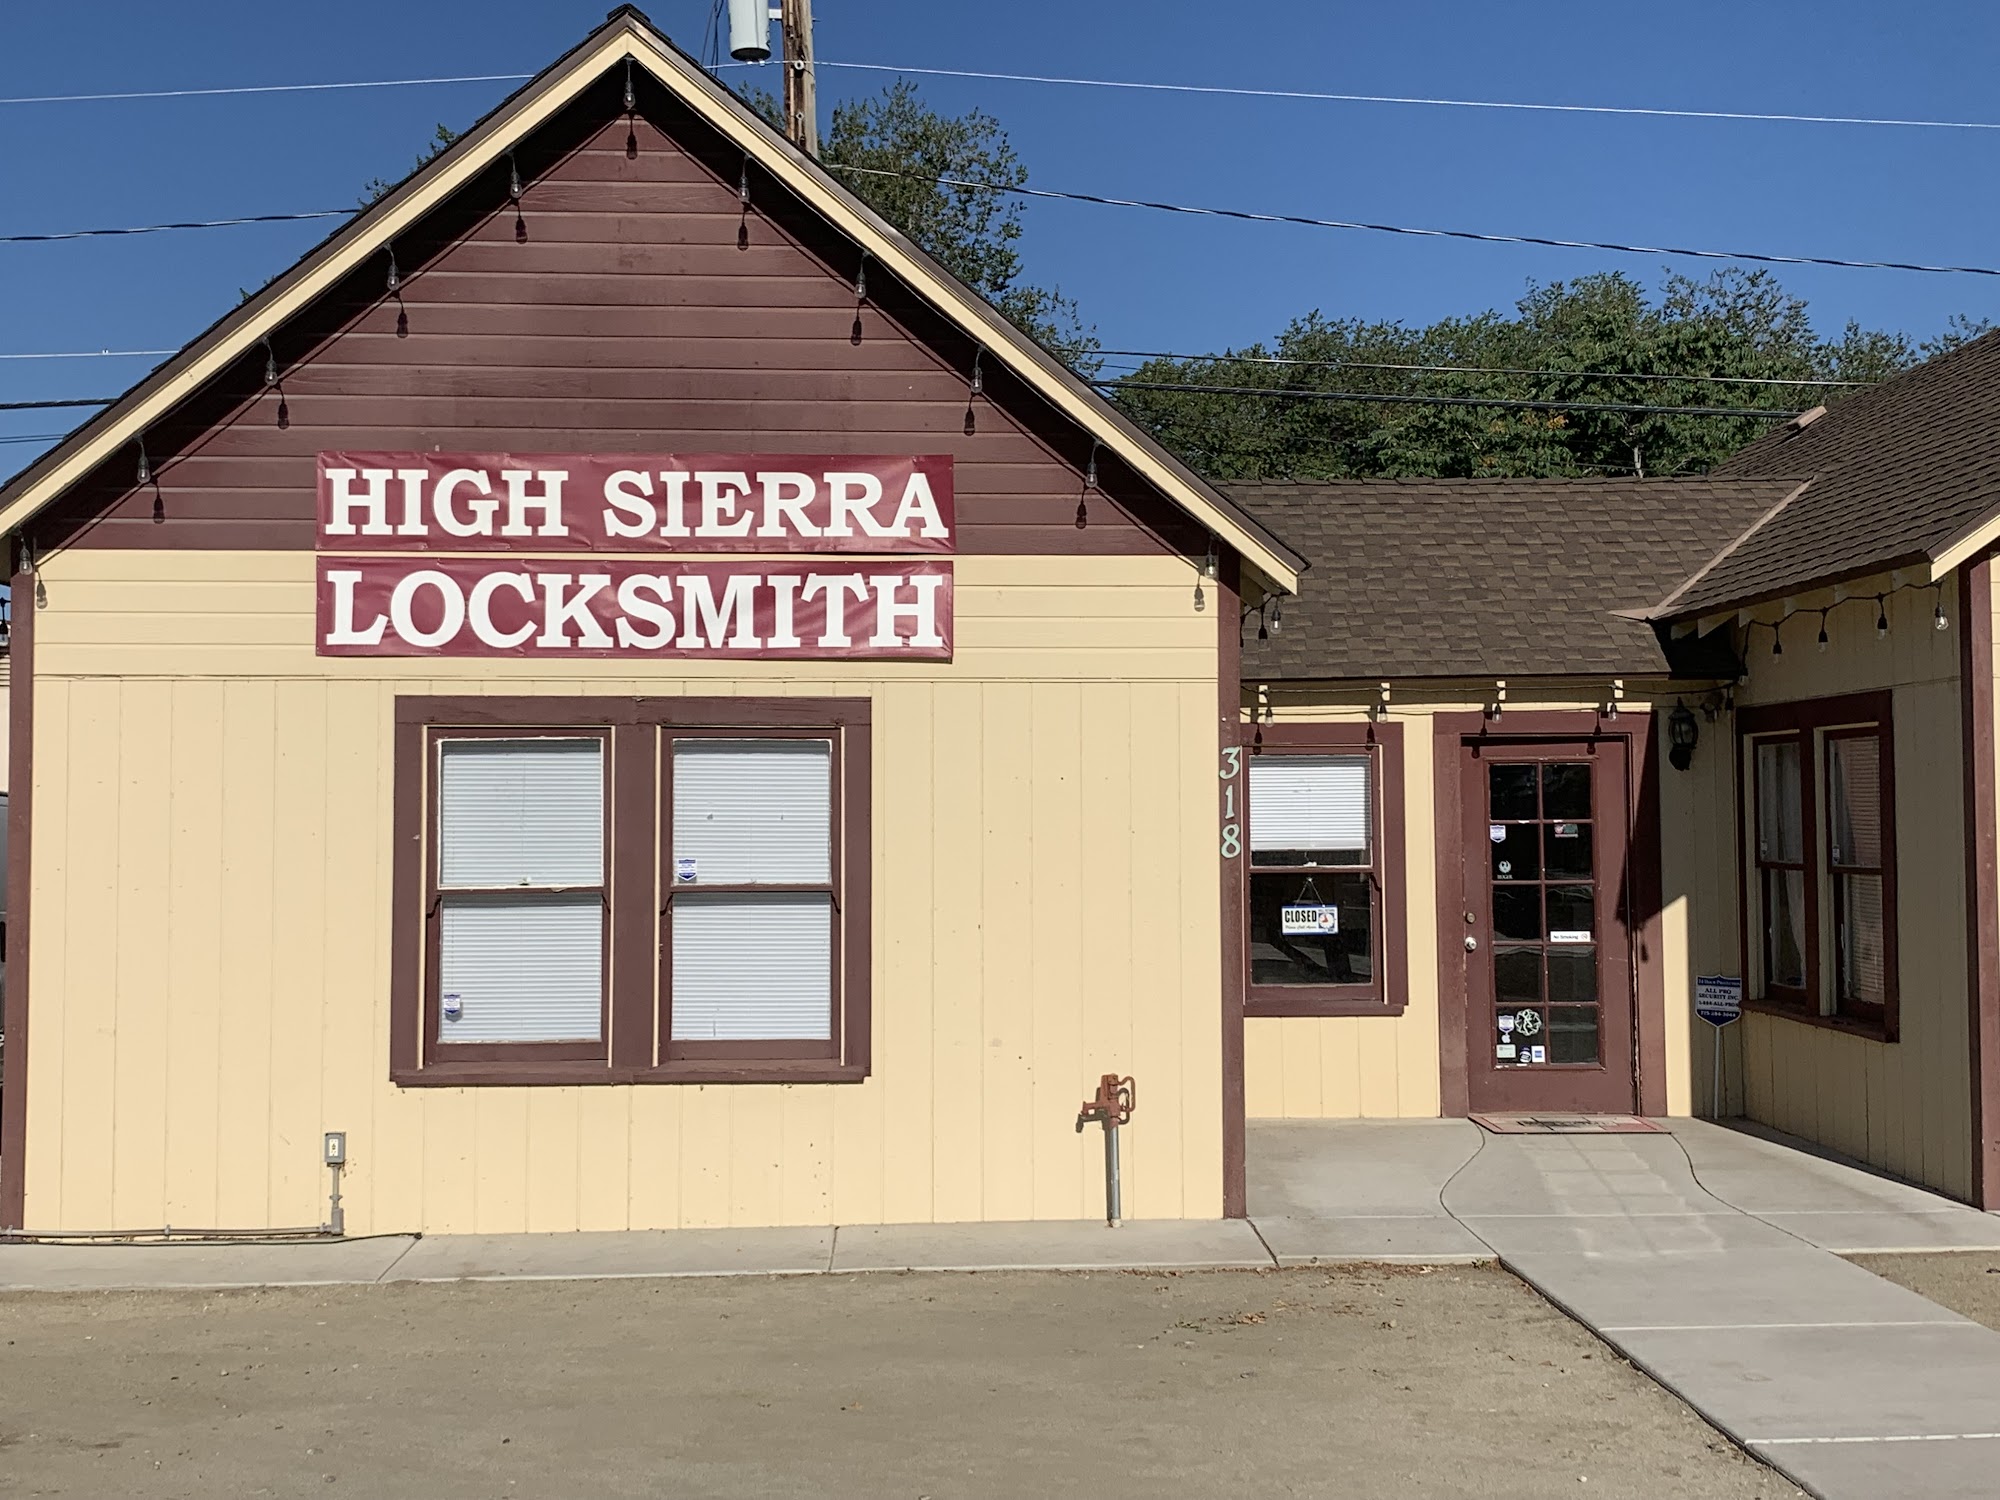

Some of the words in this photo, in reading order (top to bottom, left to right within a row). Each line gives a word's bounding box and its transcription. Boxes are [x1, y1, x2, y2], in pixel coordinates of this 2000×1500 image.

[325, 468, 569, 537] HIGH
[603, 470, 950, 540] SIERRA
[325, 569, 945, 650] LOCKSMITH
[1219, 746, 1241, 858] 318
[1284, 910, 1317, 923] CLOSED
